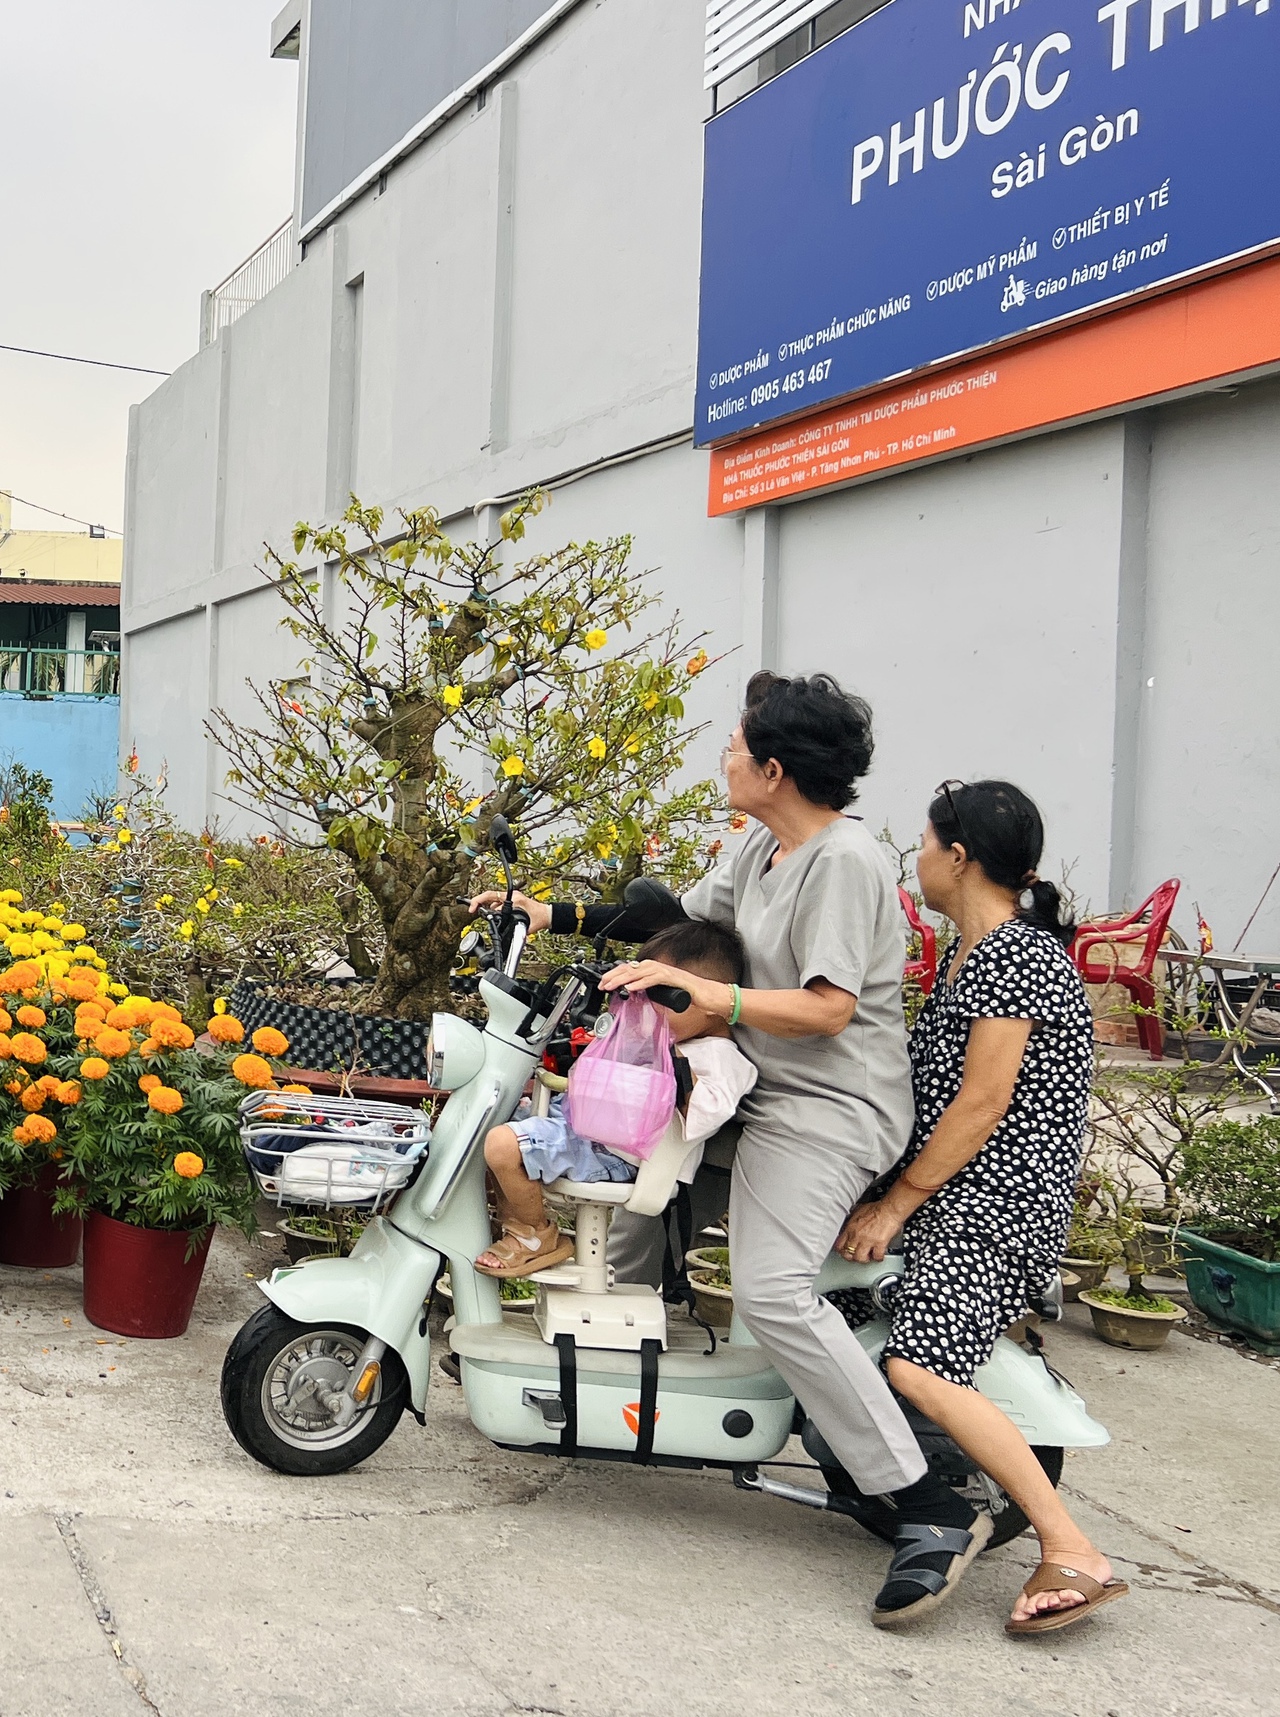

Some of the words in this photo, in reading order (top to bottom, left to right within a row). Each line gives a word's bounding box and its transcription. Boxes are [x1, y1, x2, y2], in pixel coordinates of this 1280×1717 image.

[852, 32, 1071, 205] PHƯỚC
[991, 143, 1046, 198] Sài
[1059, 108, 1138, 166] Gòn
[719, 364, 742, 386] DƯỢC
[744, 348, 769, 376] PHẨM
[788, 334, 814, 357] THỰC
[816, 317, 845, 346] PHẨM
[846, 307, 876, 334] CHỨC
[879, 294, 911, 321] NĂNG
[939, 268, 974, 296] DƯỢC
[976, 254, 996, 281] MỸ
[999, 236, 1038, 272] PHẨM
[1068, 206, 1111, 243] THIẾT
[1114, 202, 1130, 225] BỊ
[1134, 196, 1145, 216] Y
[1149, 177, 1170, 211] TẾ
[1035, 276, 1068, 299] Giao
[1071, 260, 1109, 287] hàng
[1112, 249, 1136, 273] tận
[1140, 233, 1168, 260] nơi
[708, 395, 748, 423] Hotline:
[750, 378, 779, 406] 0905
[782, 369, 804, 394] 463
[808, 359, 832, 384] 467
[755, 447, 771, 460] Kinh
[772, 438, 797, 453] Doanh:
[798, 427, 821, 445] CÔNG
[823, 423, 834, 437] TY
[835, 417, 858, 434] TNHH
[860, 411, 872, 425] TM
[874, 402, 899, 421] DƯỢC
[901, 389, 928, 412] PHẨM
[930, 381, 964, 403] PHƯỚC
[967, 371, 997, 391] THIỆN
[723, 472, 738, 487] NHÀ
[740, 462, 763, 480] THUỐC
[765, 456, 790, 473] PHƯỚC
[792, 448, 815, 464] THIỆN
[816, 442, 829, 458] SÀI
[831, 437, 850, 453] GÒN
[749, 483, 759, 496] Số
[760, 481, 765, 493] 3
[766, 479, 775, 491] Lê
[776, 475, 790, 488] Văn
[791, 469, 806, 484] Việt
[811, 466, 818, 478] P.
[820, 461, 839, 474] Tăng
[841, 455, 861, 469] Nhơn
[864, 449, 880, 463] Phú
[887, 441, 900, 456] TP.
[902, 434, 914, 451] Hồ
[916, 430, 932, 446] Chí
[933, 425, 956, 443] Minh
